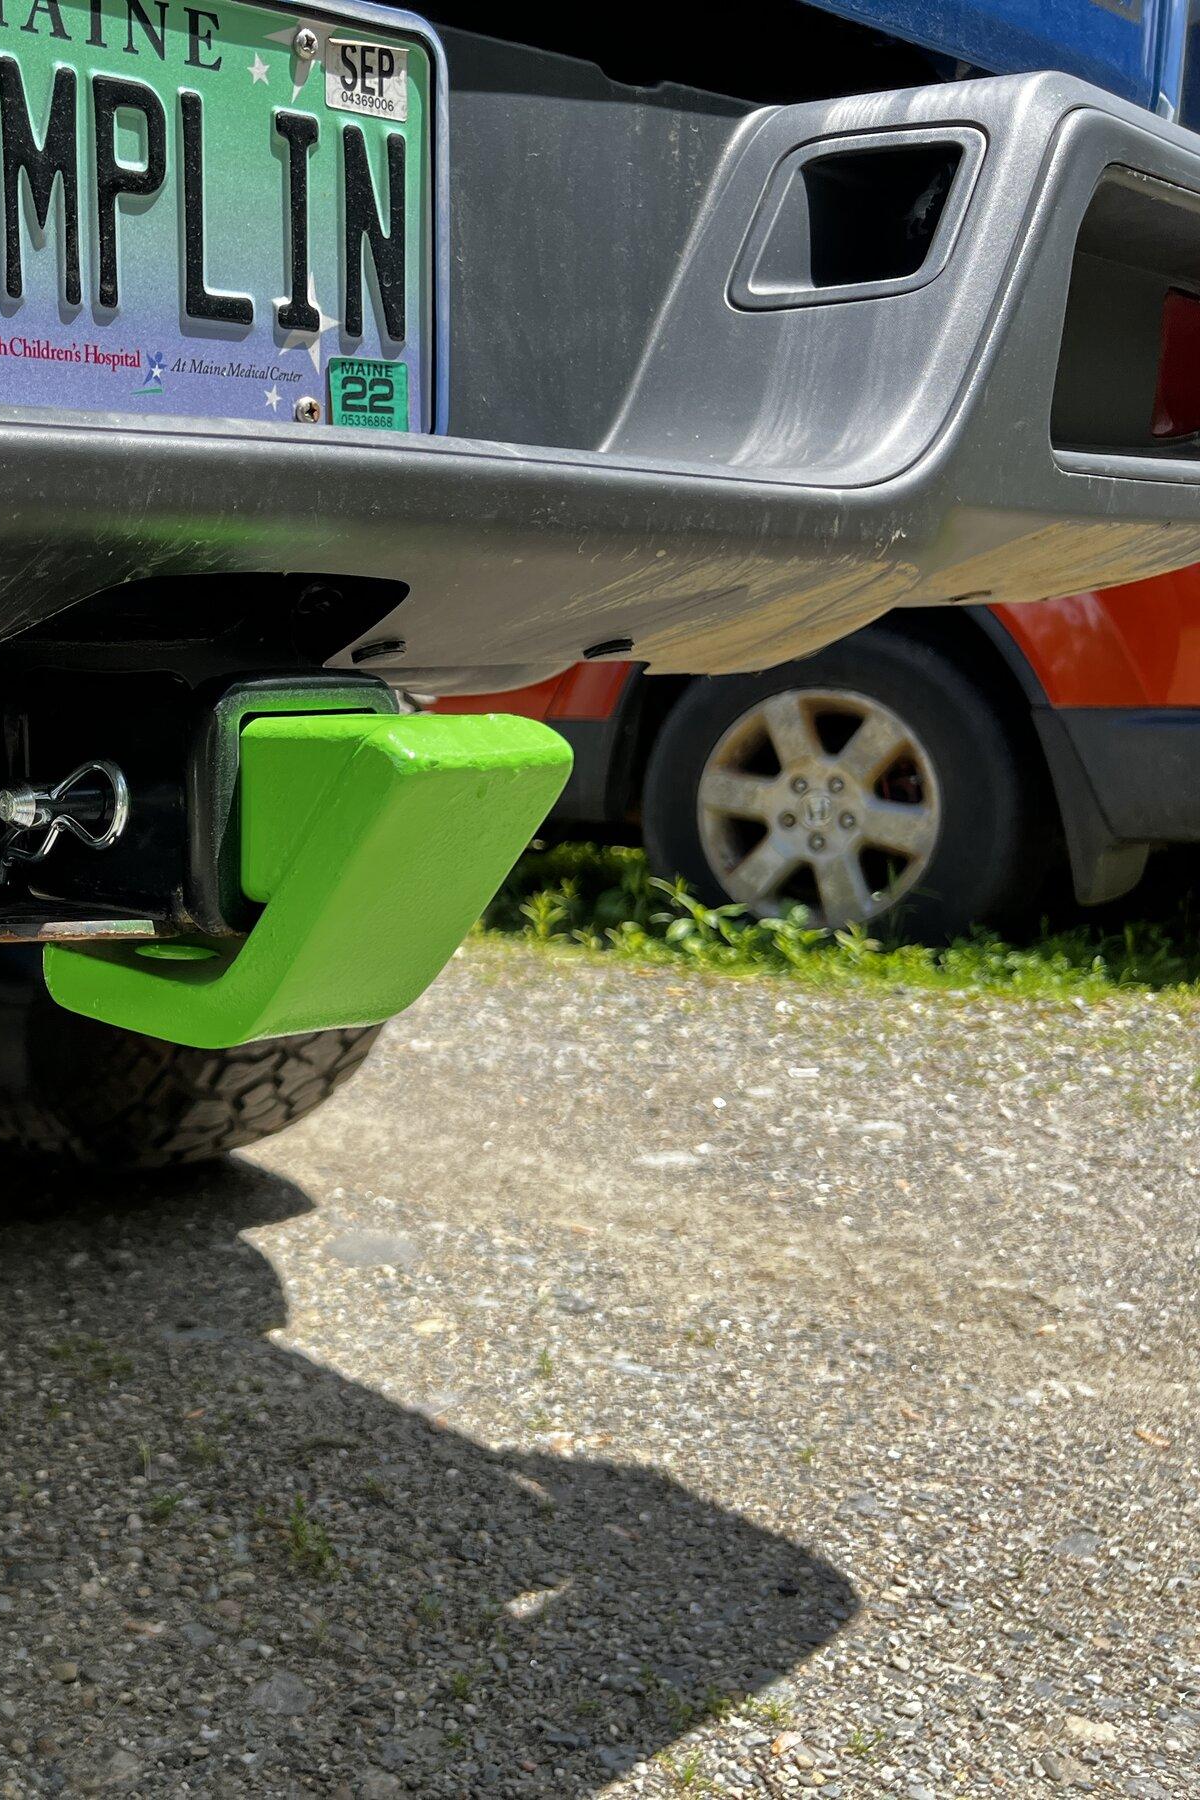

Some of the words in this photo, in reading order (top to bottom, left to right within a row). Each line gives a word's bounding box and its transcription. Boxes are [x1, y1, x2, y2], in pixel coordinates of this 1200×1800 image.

[340, 45, 394, 97] SEP
[341, 91, 394, 112] 04369006
[9, 337, 82, 363] Children's
[84, 344, 142, 372] Hospital
[170, 357, 187, 374] At
[189, 358, 226, 377] Maine
[227, 362, 270, 380] Medical
[269, 366, 303, 383] Center
[340, 361, 394, 378] MAINE
[341, 375, 395, 415] 22
[340, 413, 394, 428] 05336868
